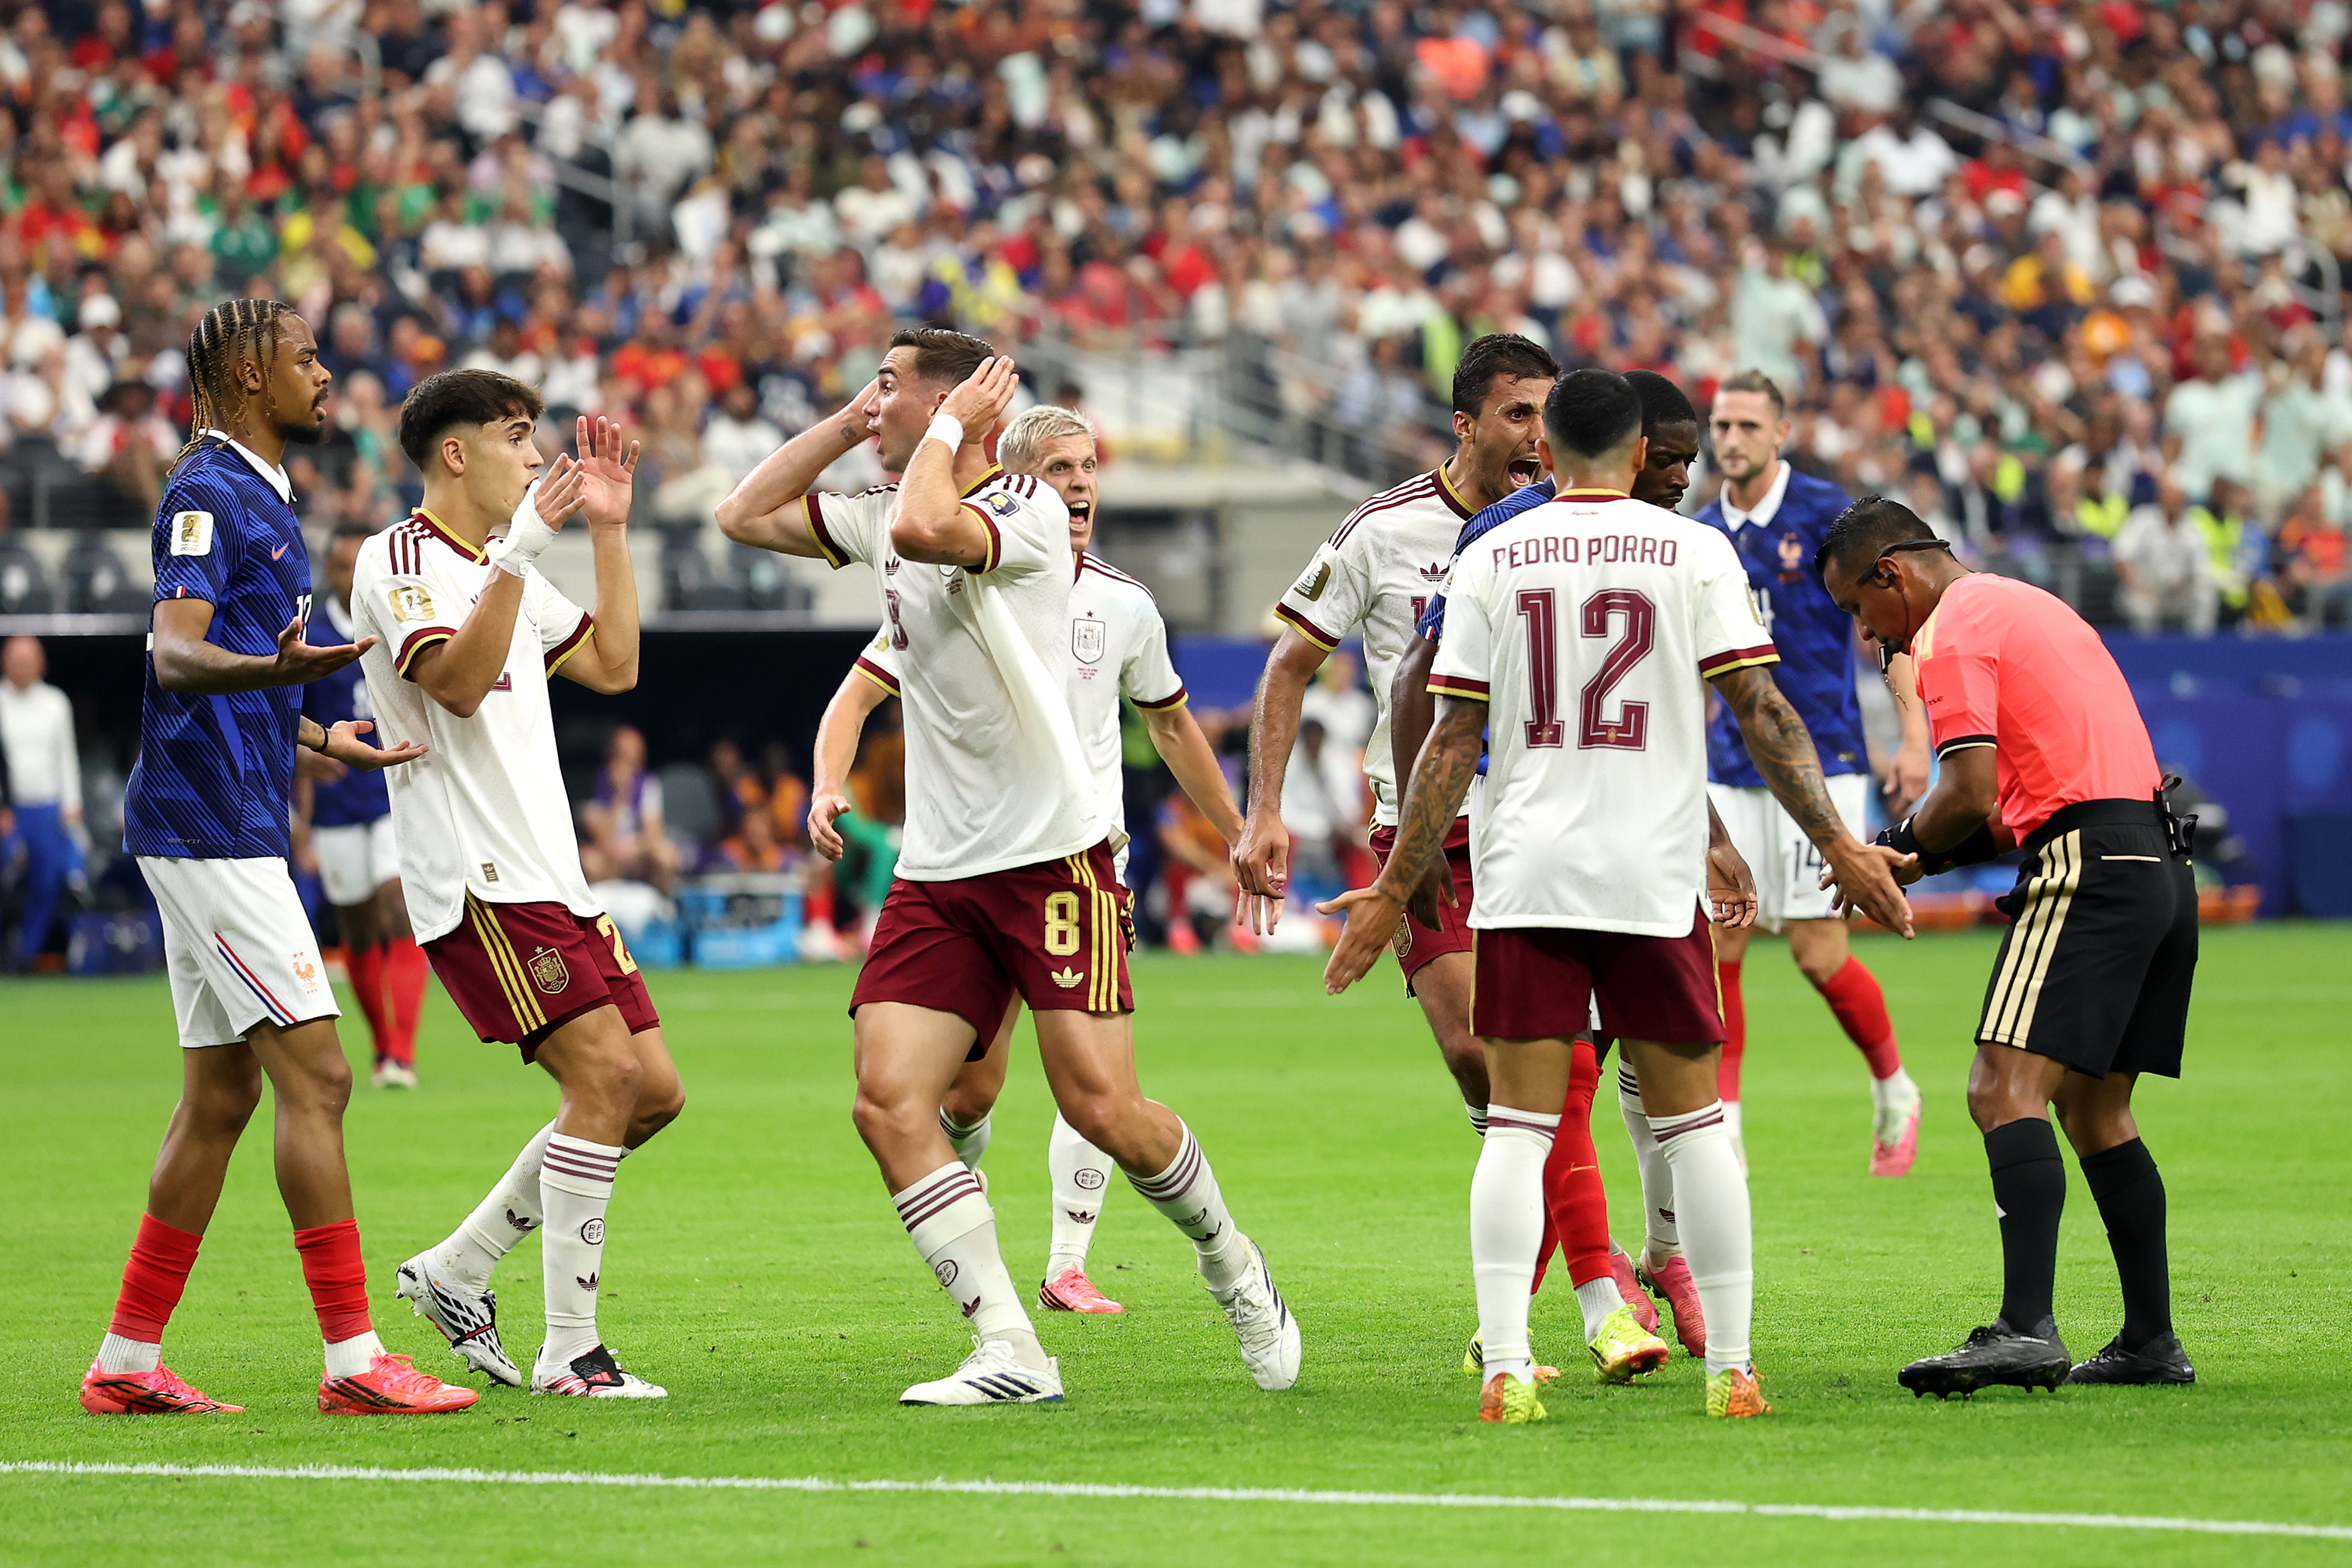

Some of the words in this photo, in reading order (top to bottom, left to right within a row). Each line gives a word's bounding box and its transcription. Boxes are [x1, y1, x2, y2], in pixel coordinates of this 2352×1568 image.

[1492, 536, 1579, 573] PEDRO
[1587, 535, 1677, 566] PORRO
[1516, 588, 1656, 752] 12
[1793, 839, 1823, 881] 14
[596, 914, 638, 976] 2
[1044, 891, 1080, 956] 8
